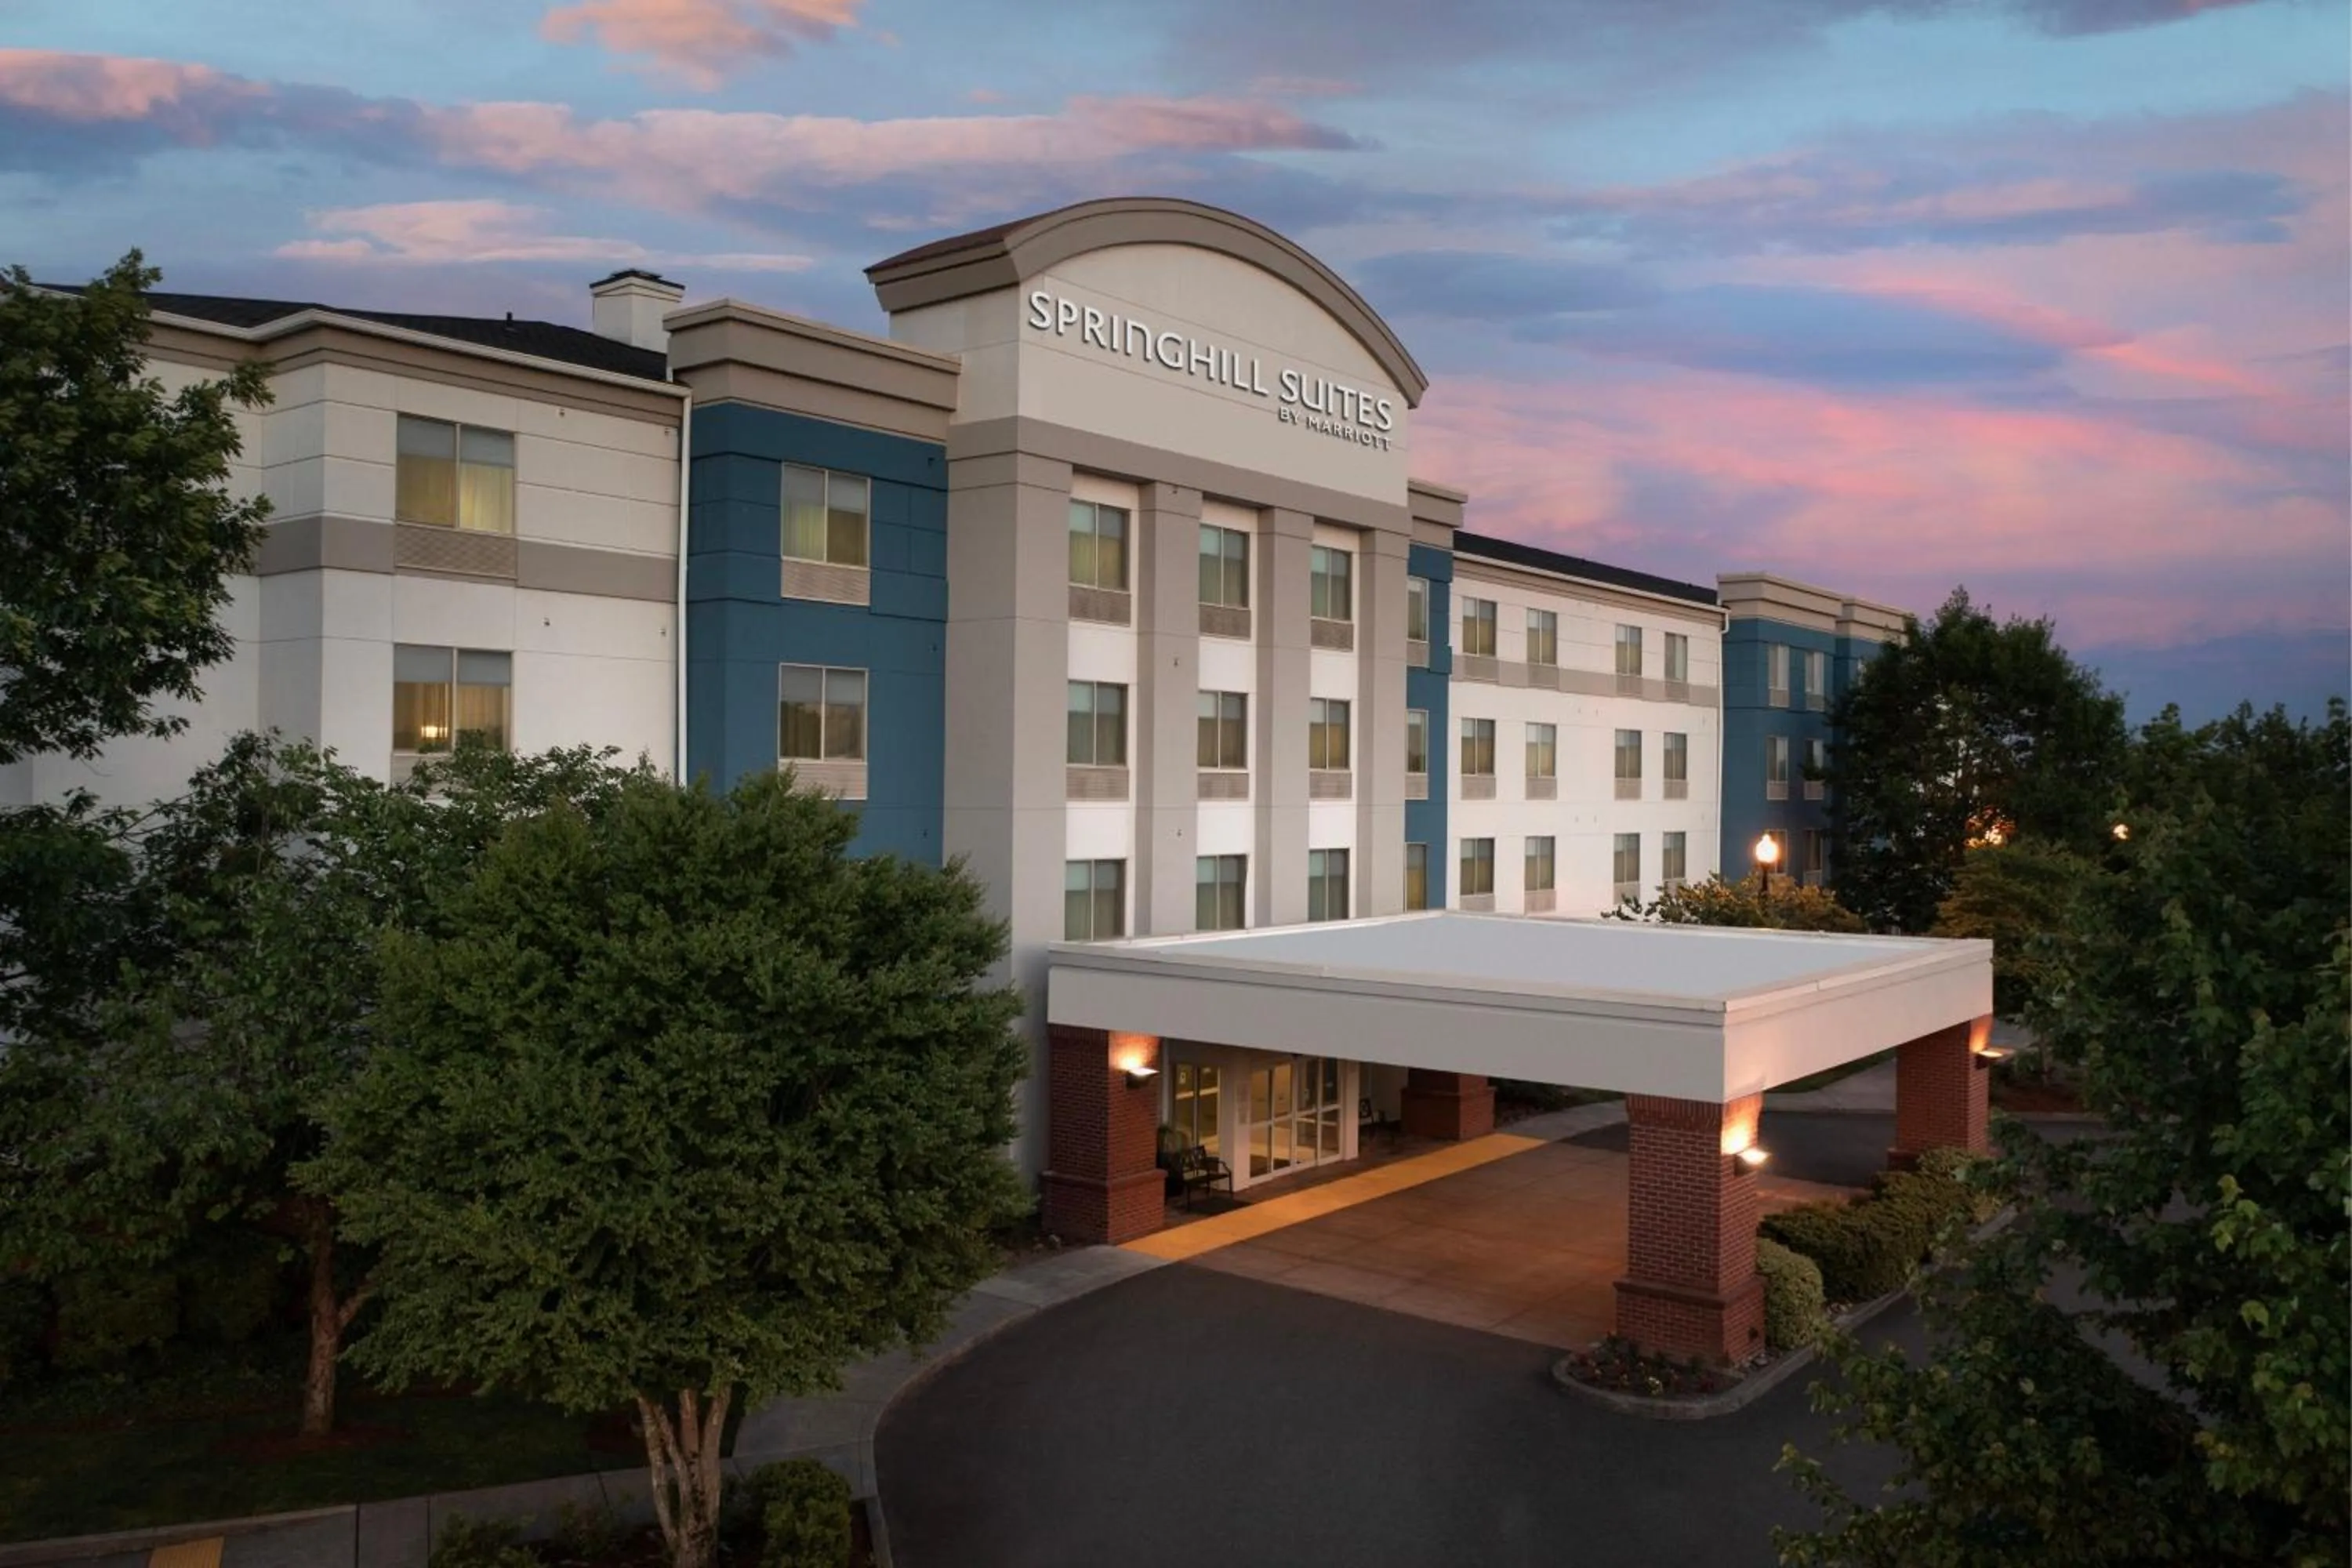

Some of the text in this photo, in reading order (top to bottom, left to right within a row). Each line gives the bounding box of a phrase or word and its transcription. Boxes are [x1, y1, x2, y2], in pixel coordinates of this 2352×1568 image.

[1028, 290, 1392, 431] SPRINGHILL SUITES
[1279, 406, 1392, 452] BY MARRIOTT
